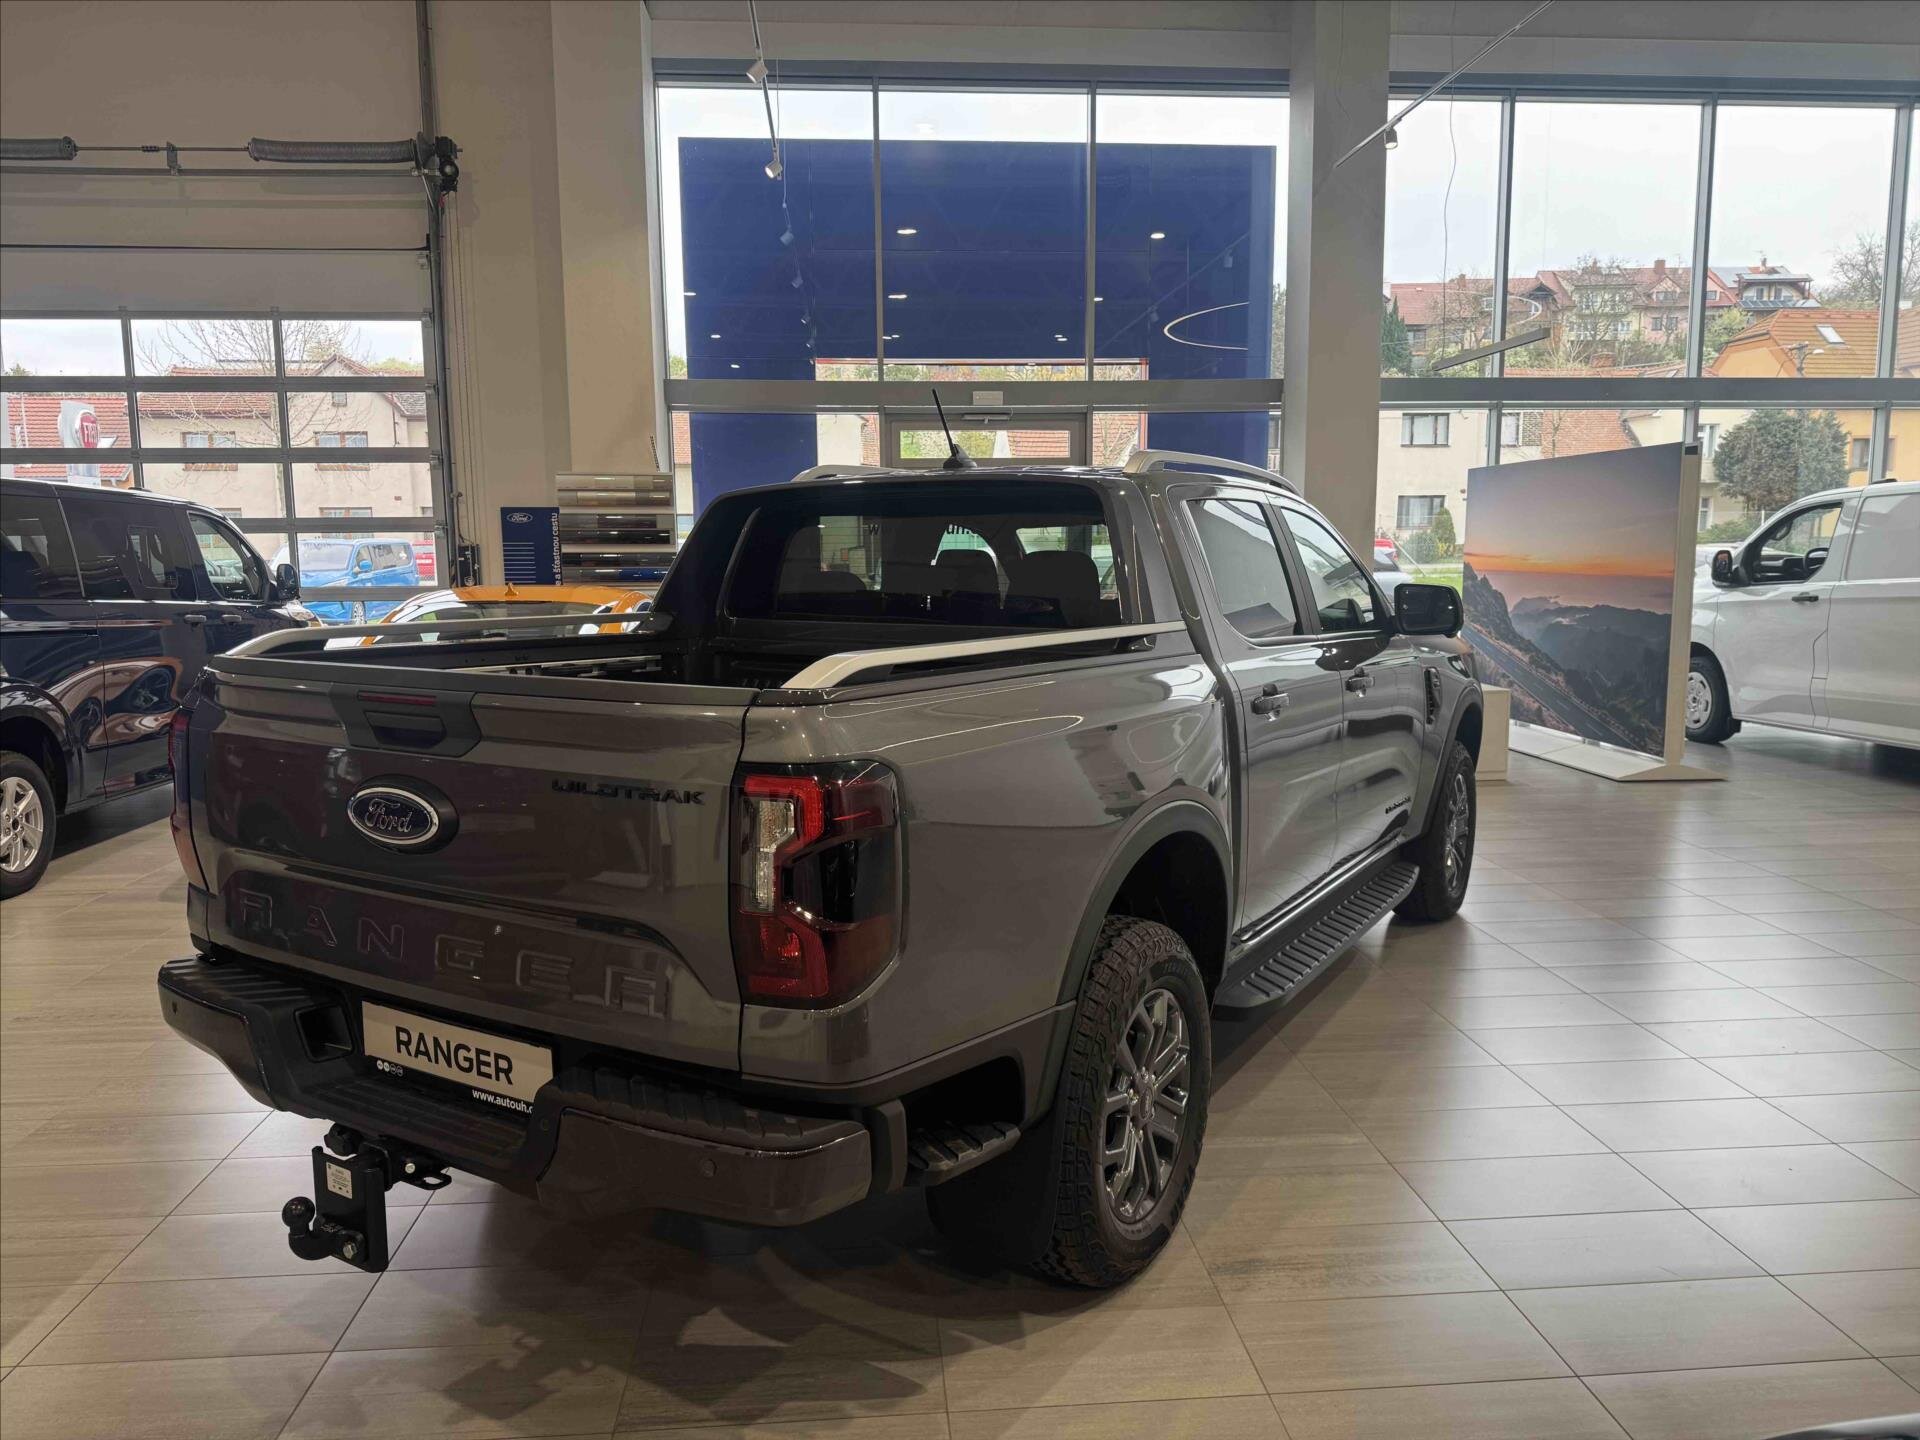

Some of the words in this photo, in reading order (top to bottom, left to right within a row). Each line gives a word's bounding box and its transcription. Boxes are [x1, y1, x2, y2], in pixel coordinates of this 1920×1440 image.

[551, 512, 559, 536] cestu
[238, 886, 672, 1022] RANGER
[395, 1026, 514, 1086] RANGER
